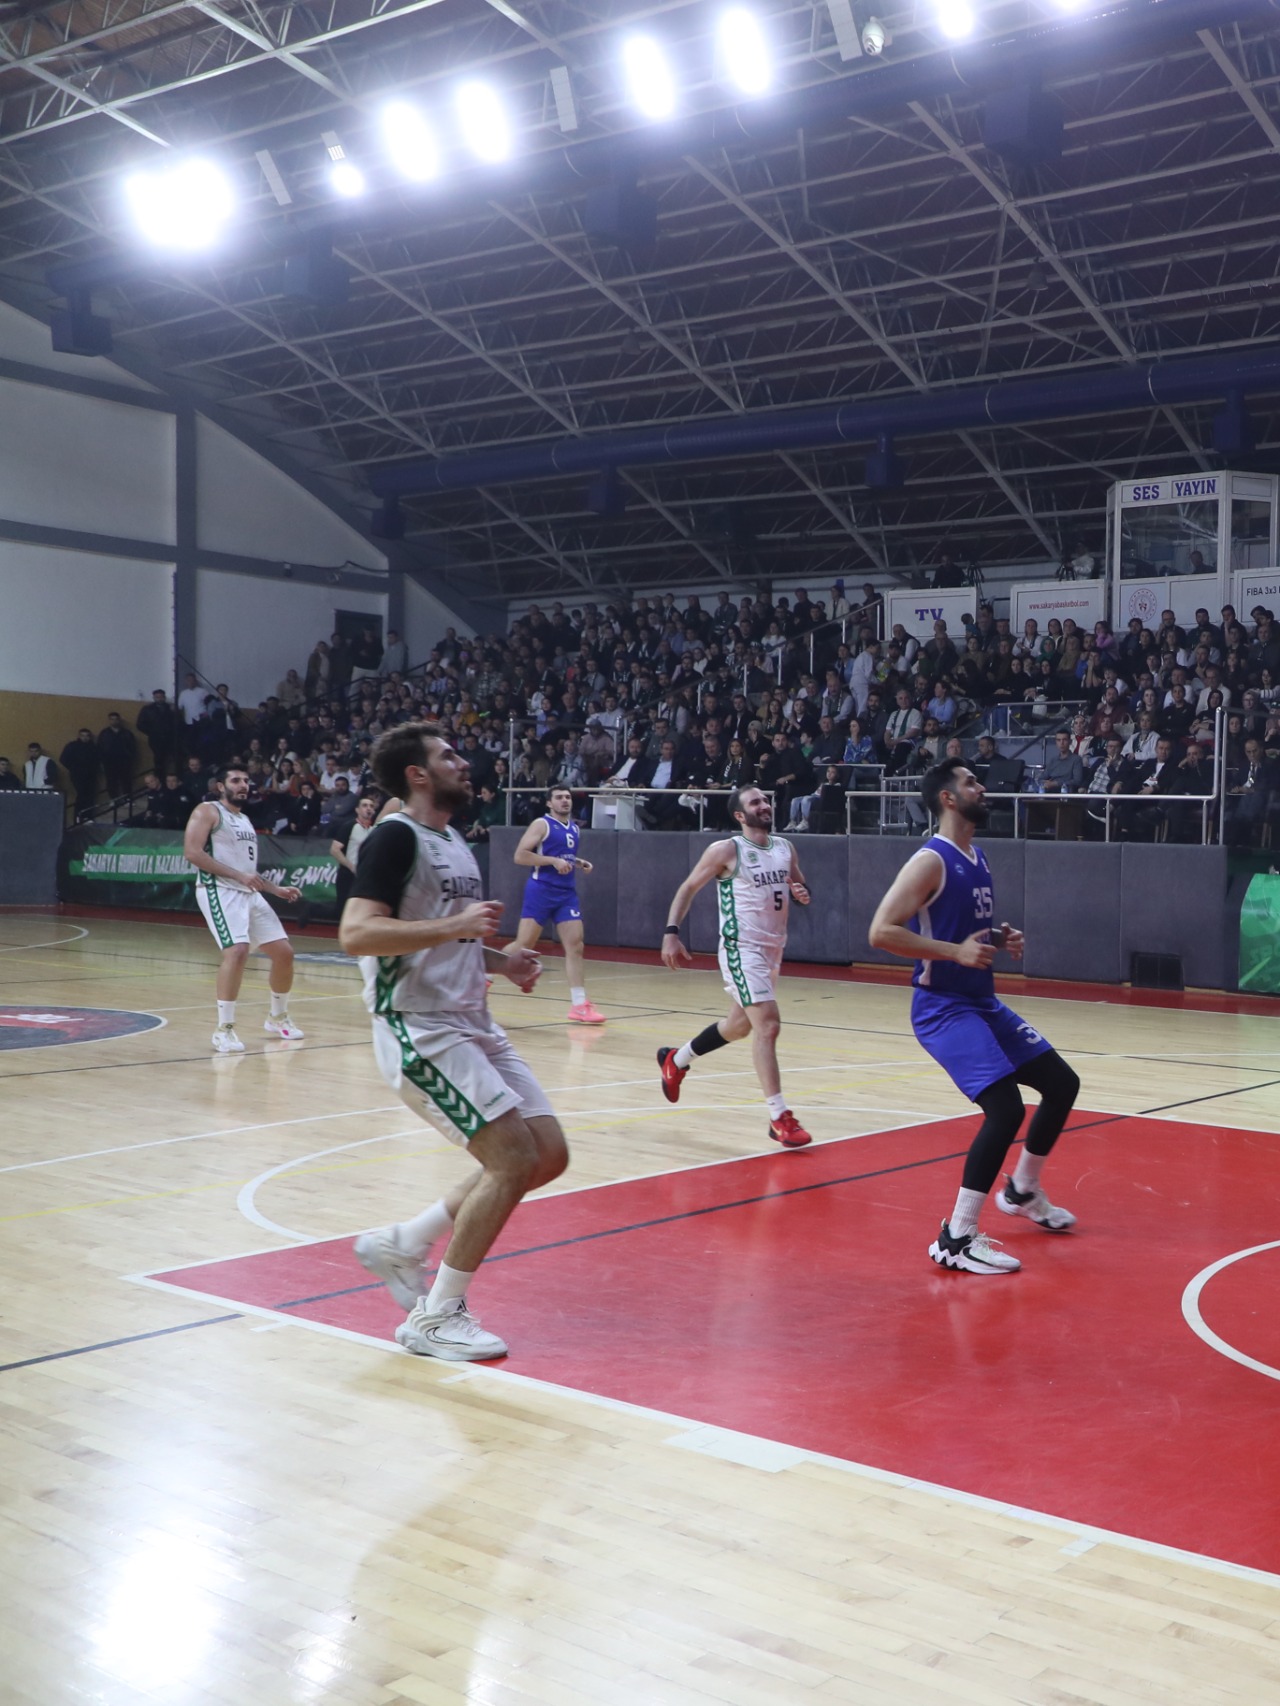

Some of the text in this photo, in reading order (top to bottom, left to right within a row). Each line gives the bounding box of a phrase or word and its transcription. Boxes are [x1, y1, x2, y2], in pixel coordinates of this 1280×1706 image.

[1133, 479, 1217, 501] SES YAYIN
[1246, 587, 1264, 597] FIBA
[1265, 586, 1277, 595] 3x3
[1029, 600, 1089, 611] www.sakaryabasketbol.com
[915, 608, 944, 621] TV
[566, 833, 575, 849] 6
[248, 846, 254, 861] 9
[773, 890, 783, 912] 5
[972, 886, 993, 919] 35
